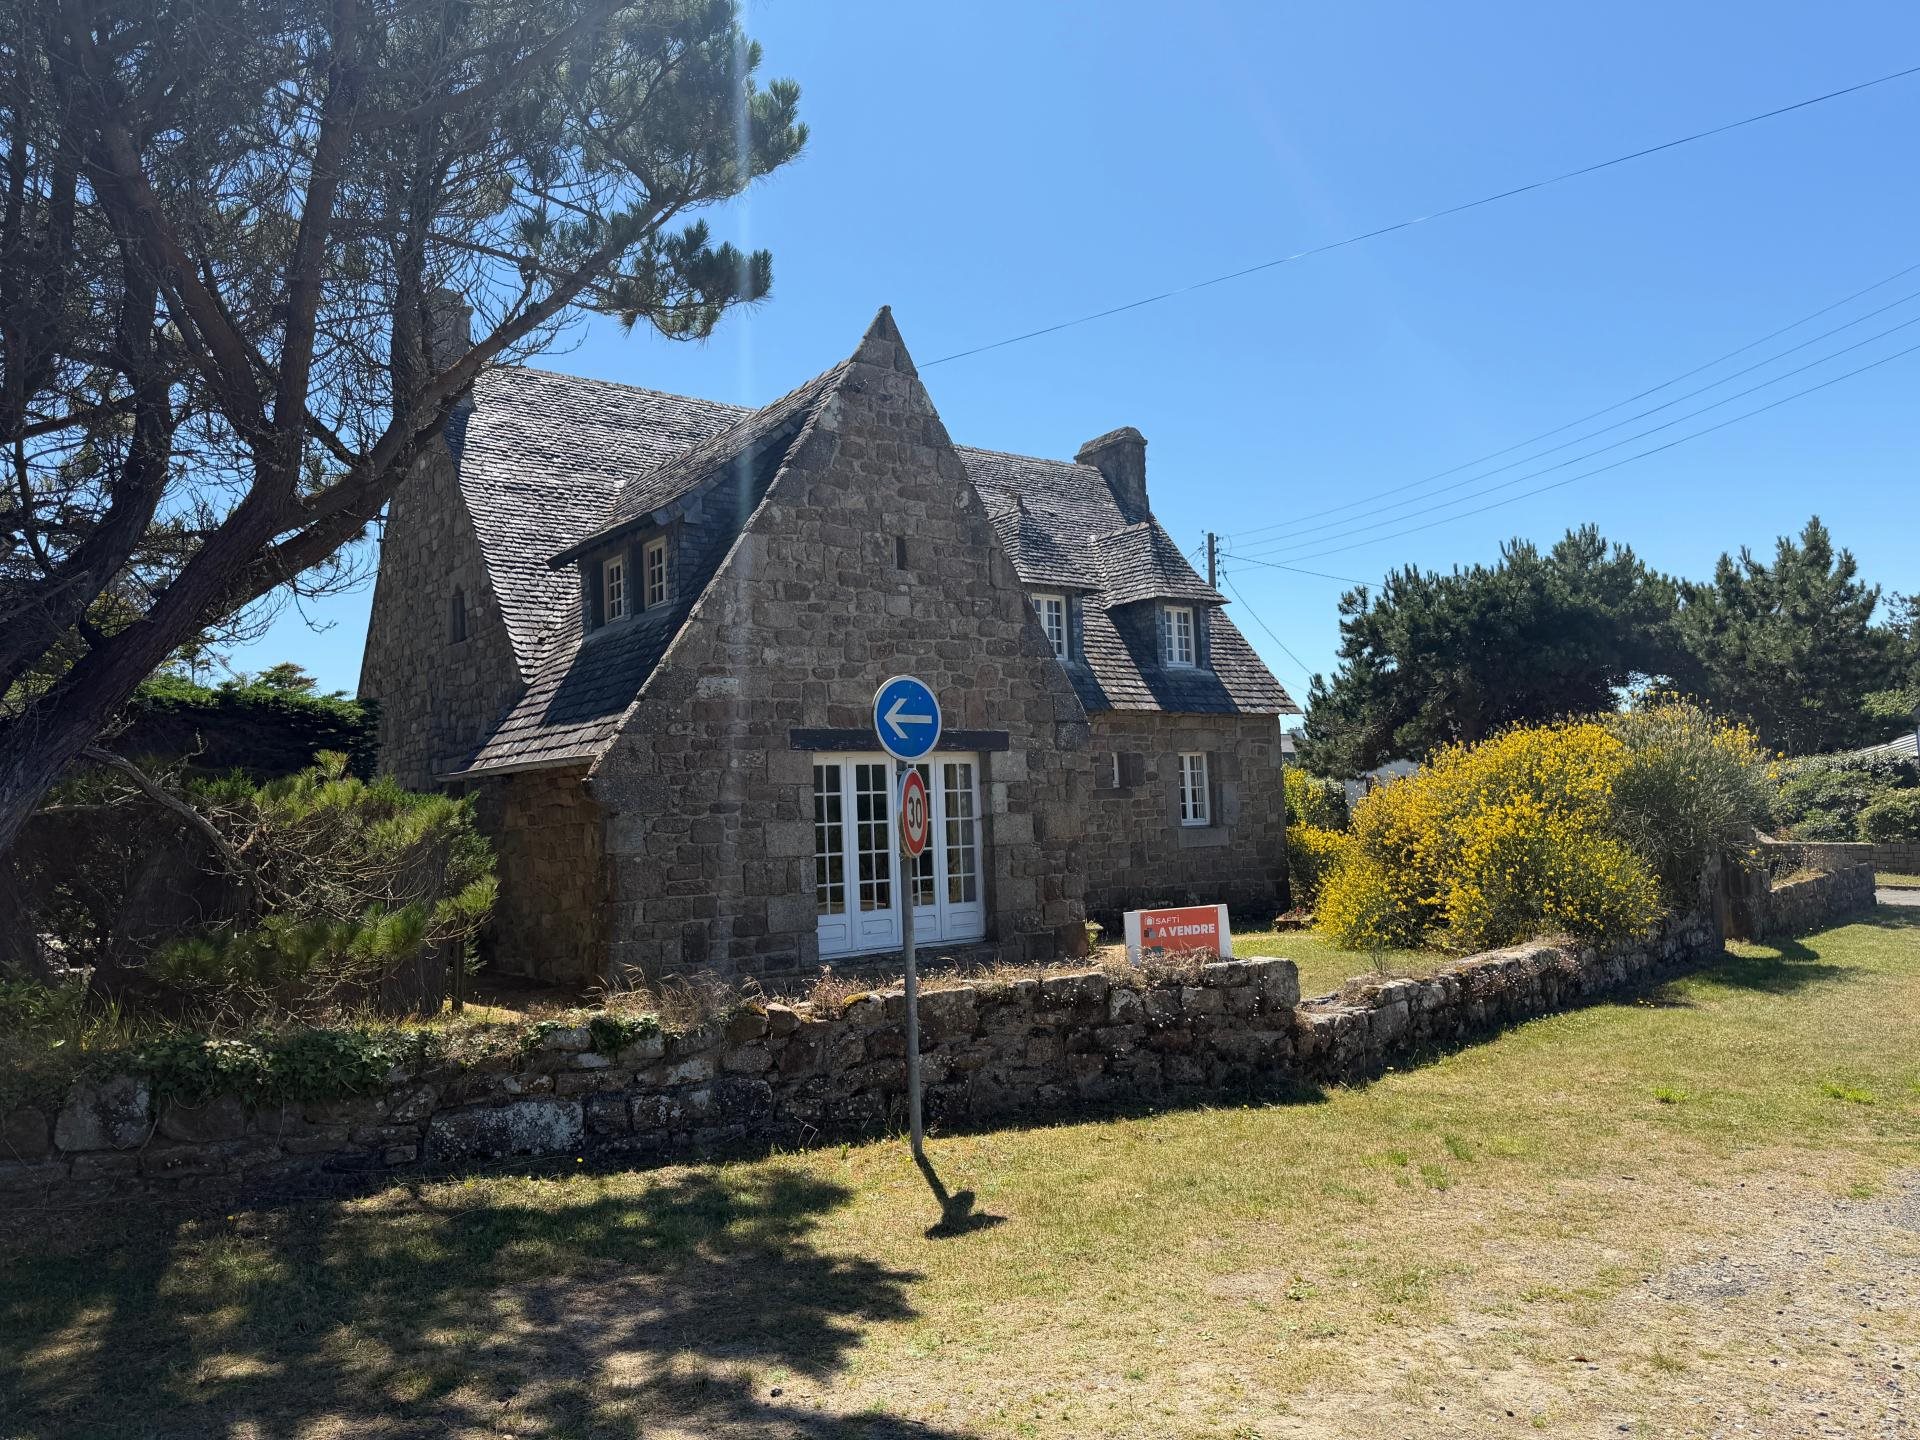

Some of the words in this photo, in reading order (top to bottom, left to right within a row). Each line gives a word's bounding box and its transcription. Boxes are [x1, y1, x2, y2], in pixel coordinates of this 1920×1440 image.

[908, 796, 922, 829] 30
[1158, 927, 1167, 938] A
[1169, 923, 1216, 937] VENDRE
